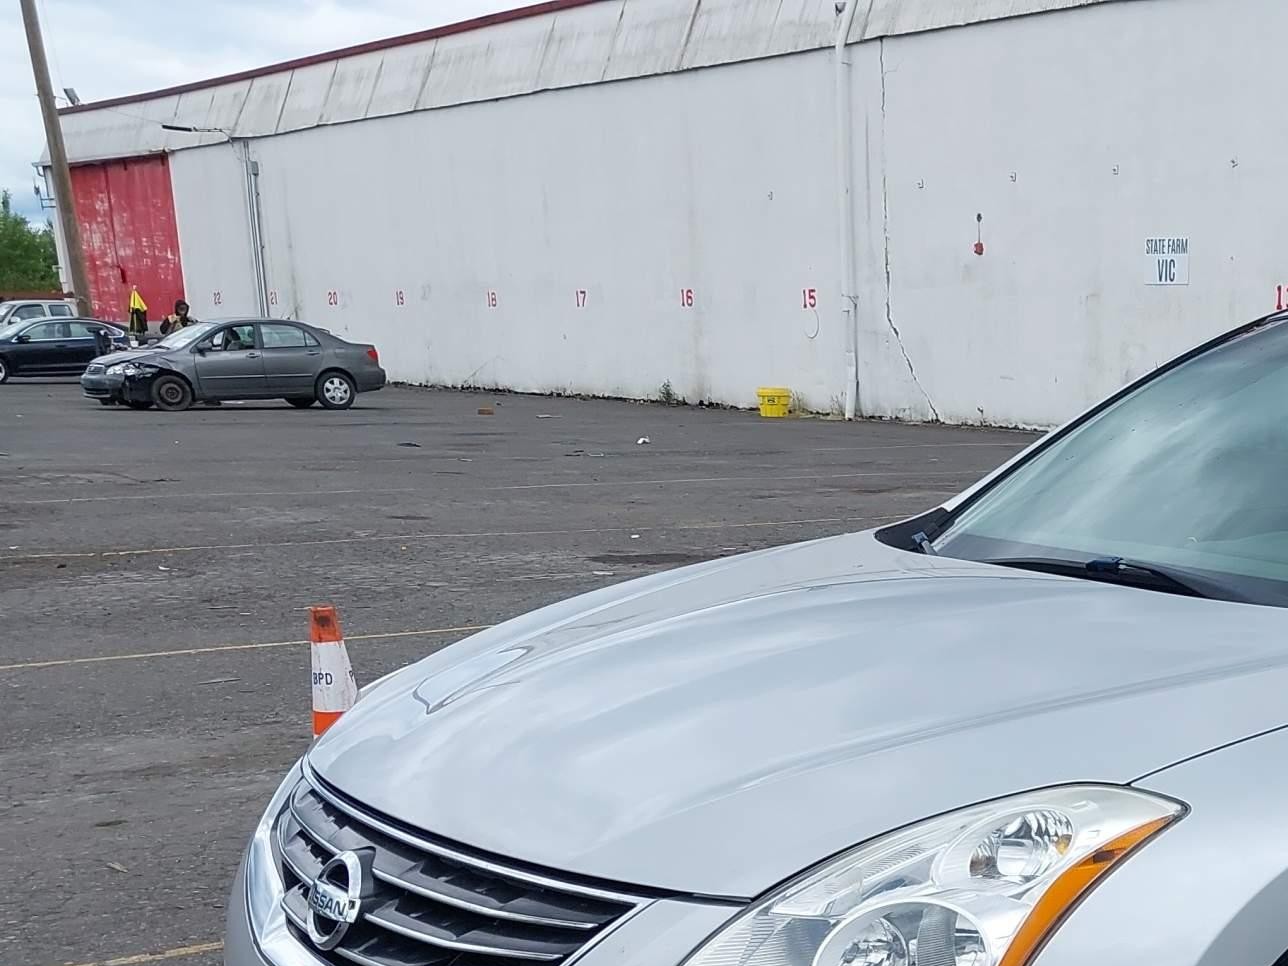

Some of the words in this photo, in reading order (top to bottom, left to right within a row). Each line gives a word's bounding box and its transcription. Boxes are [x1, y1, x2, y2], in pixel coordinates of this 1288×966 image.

[1146, 238, 1166, 255] STATE
[1167, 238, 1188, 254] FARM
[1157, 258, 1176, 282] VIC
[328, 292, 338, 305] 20
[396, 291, 404, 305] 19
[487, 291, 497, 307] 18
[575, 291, 587, 307] 17
[680, 289, 693, 307] 16
[802, 289, 816, 309] 15
[313, 672, 333, 686] BPD
